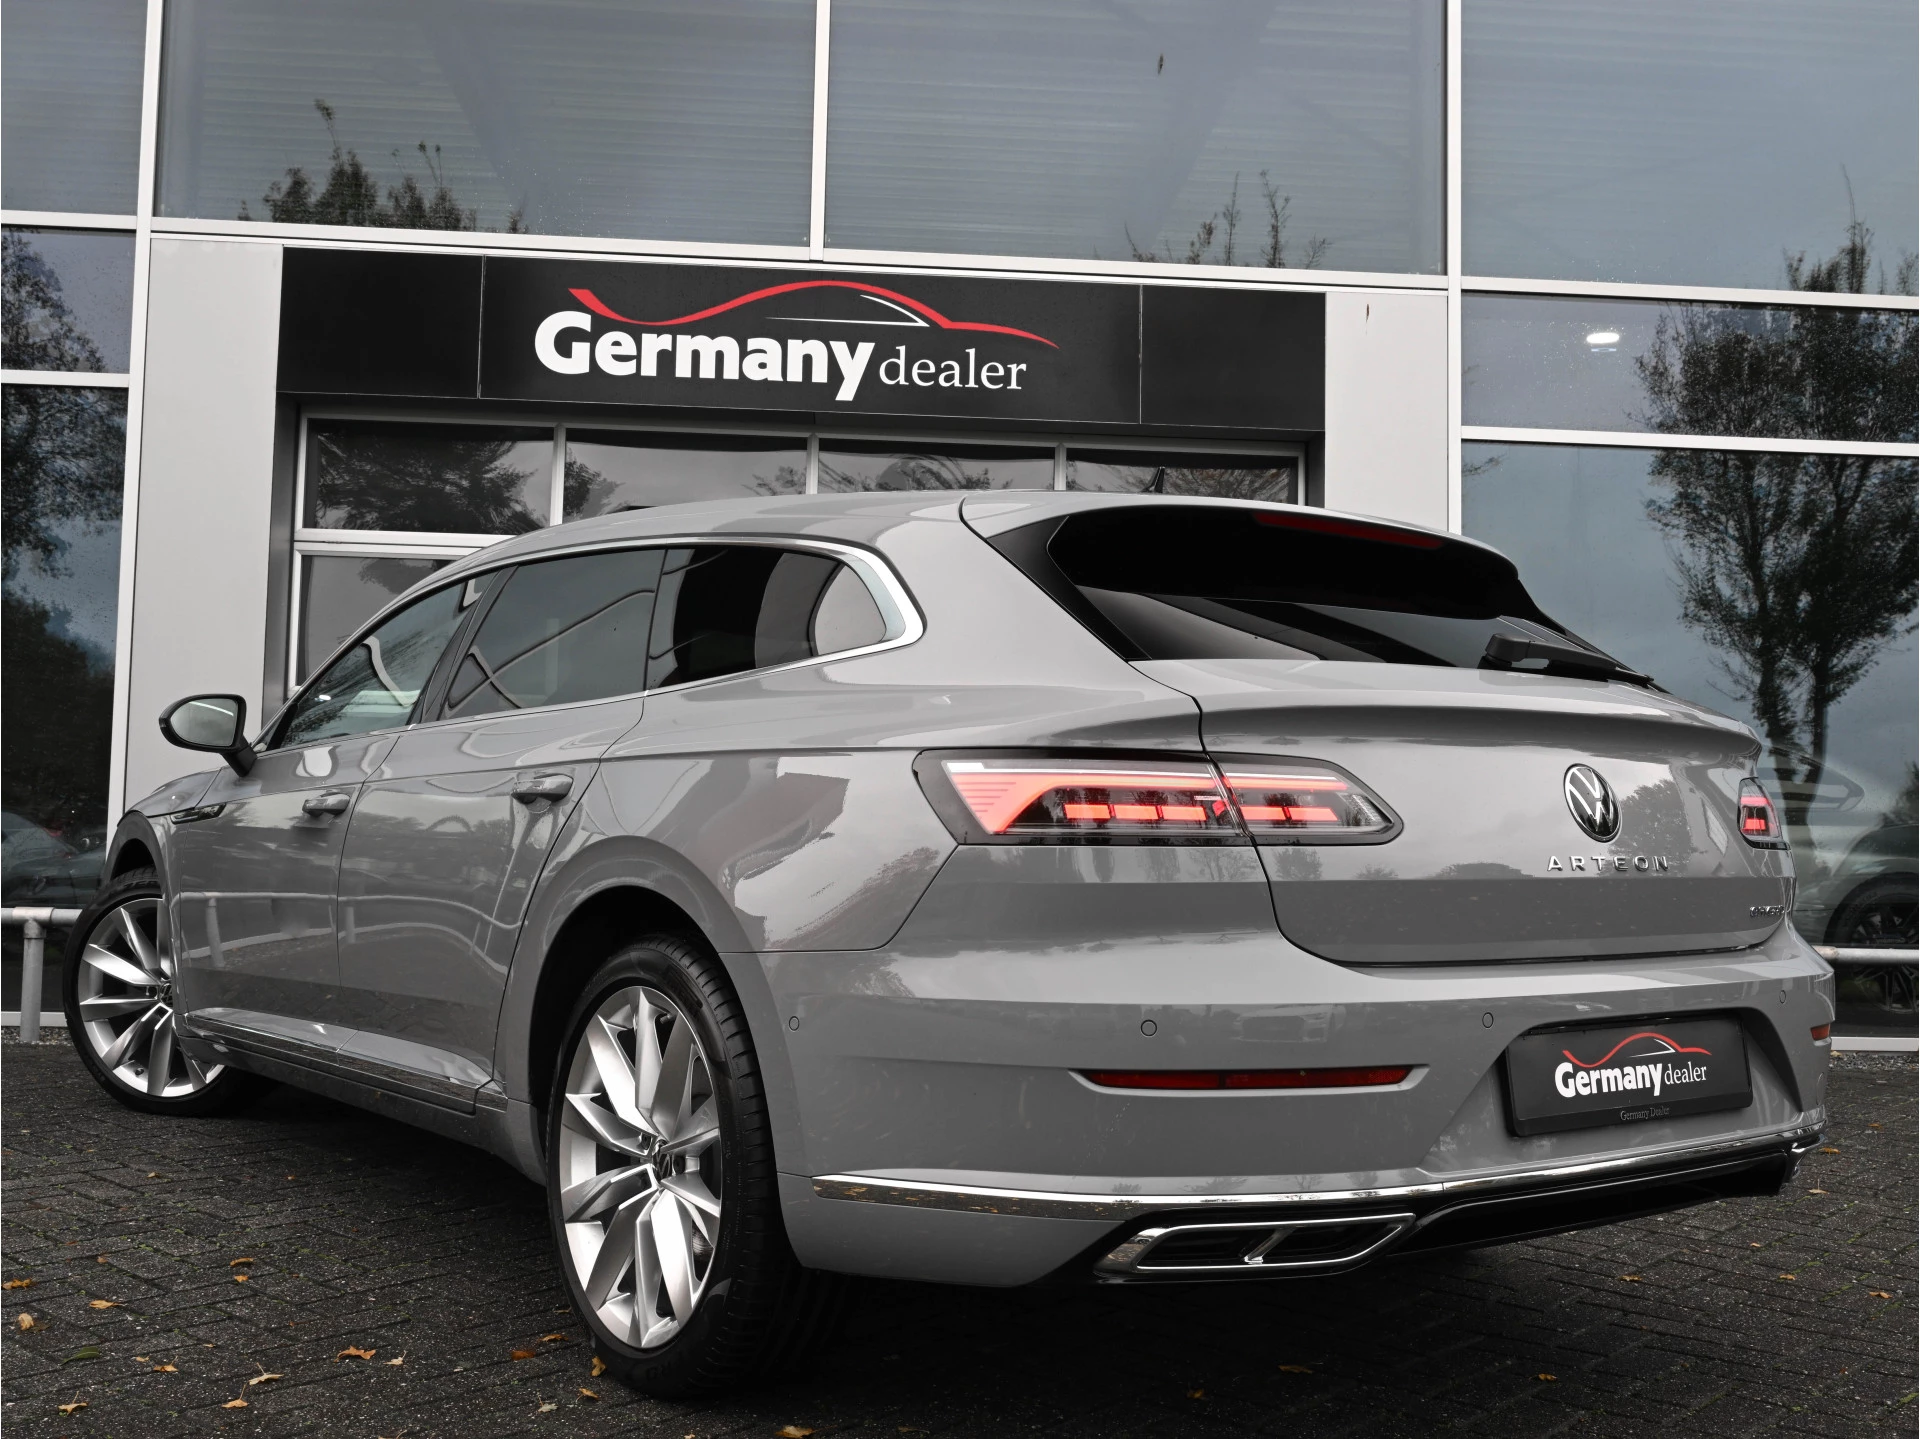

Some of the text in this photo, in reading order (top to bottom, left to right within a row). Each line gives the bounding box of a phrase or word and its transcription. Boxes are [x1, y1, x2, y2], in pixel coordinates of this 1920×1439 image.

[534, 310, 1027, 401] Germany dealer
[1547, 855, 1671, 871] ARTEON
[1554, 1061, 1707, 1098] Germany dealer
[1620, 1106, 1670, 1121] Germany Dealer
